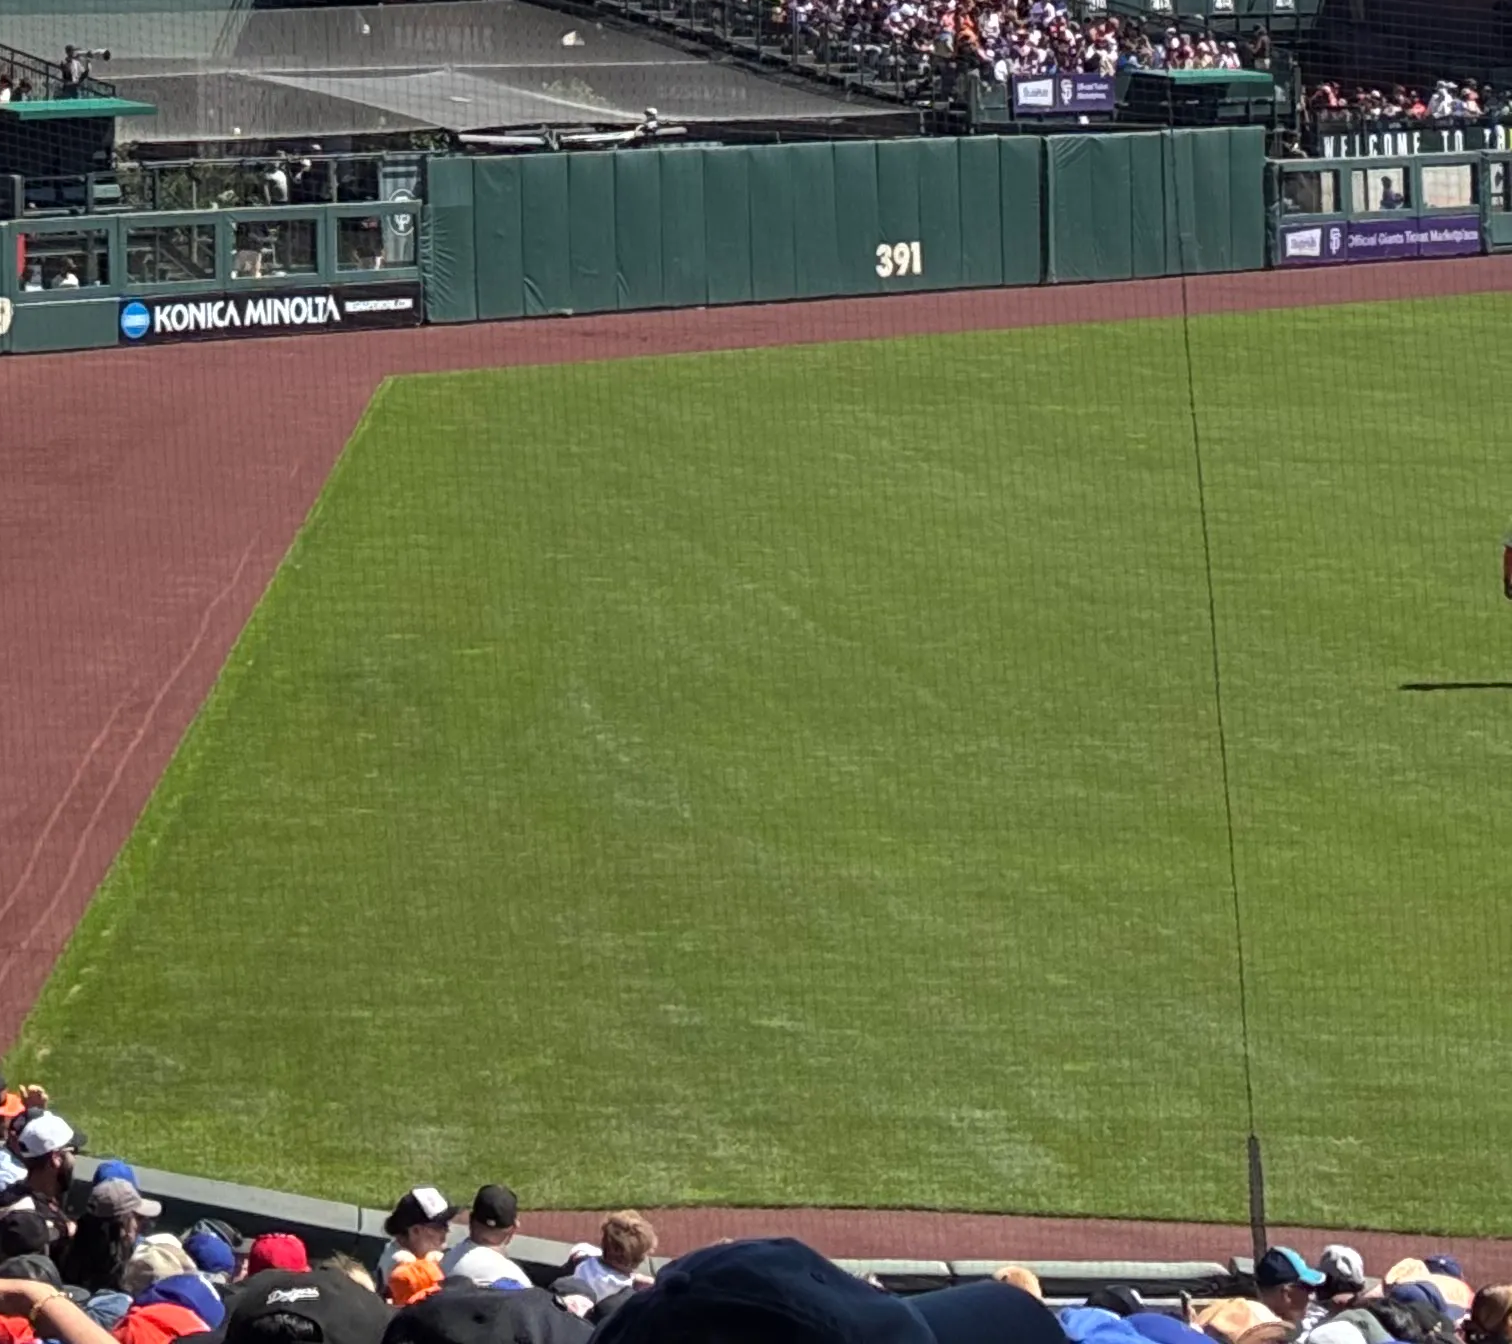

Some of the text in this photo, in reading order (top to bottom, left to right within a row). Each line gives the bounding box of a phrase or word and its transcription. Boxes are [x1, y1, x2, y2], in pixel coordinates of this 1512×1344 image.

[1324, 133, 1420, 158] WELCOME
[1441, 131, 1463, 151] TO
[876, 241, 922, 277] 391
[154, 295, 341, 333] KONICA MINOLTA
